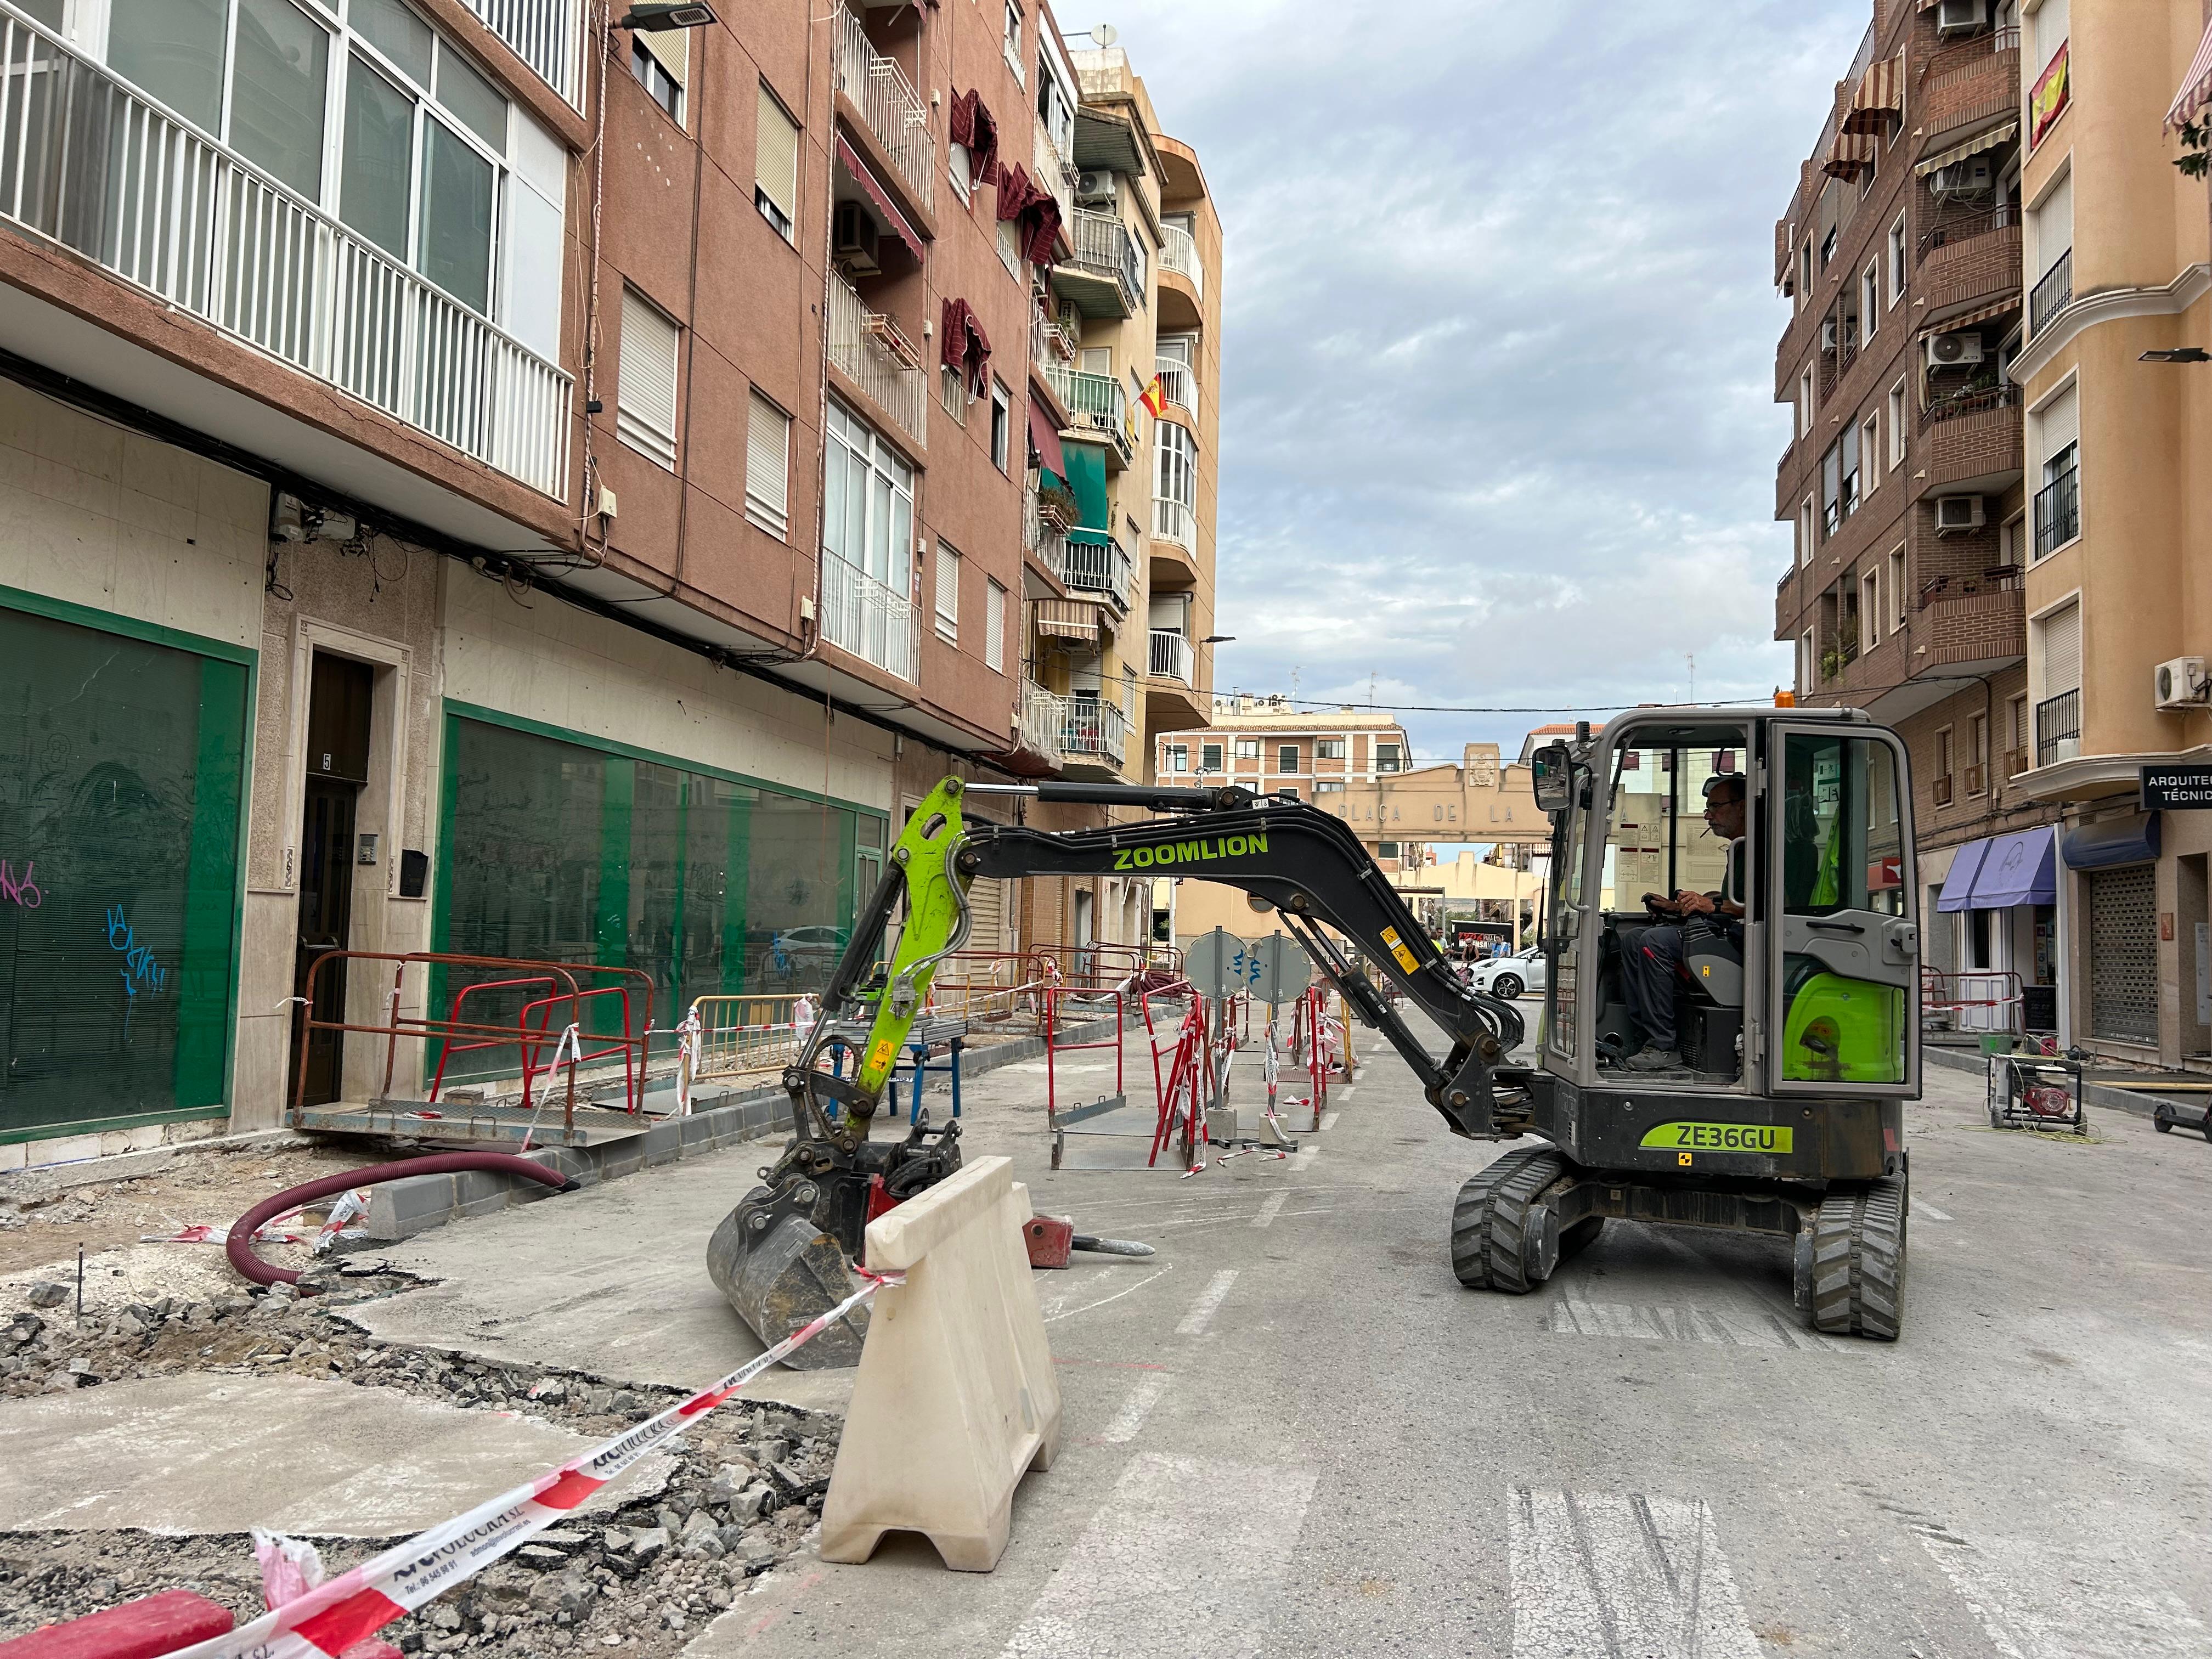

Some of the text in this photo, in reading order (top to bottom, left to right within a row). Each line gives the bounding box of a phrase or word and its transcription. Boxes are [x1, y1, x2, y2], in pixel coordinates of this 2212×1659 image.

[324, 754, 330, 769] 5
[2148, 776, 2212, 786] ARQUITE
[1338, 803, 1514, 822] PLAÇA DE LA
[1112, 833, 1268, 871] ZOOMLION
[1677, 1125, 1775, 1150] ZE36GU
[420, 1576, 429, 1587] 96
[428, 1568, 441, 1582] 545
[440, 1564, 449, 1575] 98
[448, 1560, 458, 1570] 91
